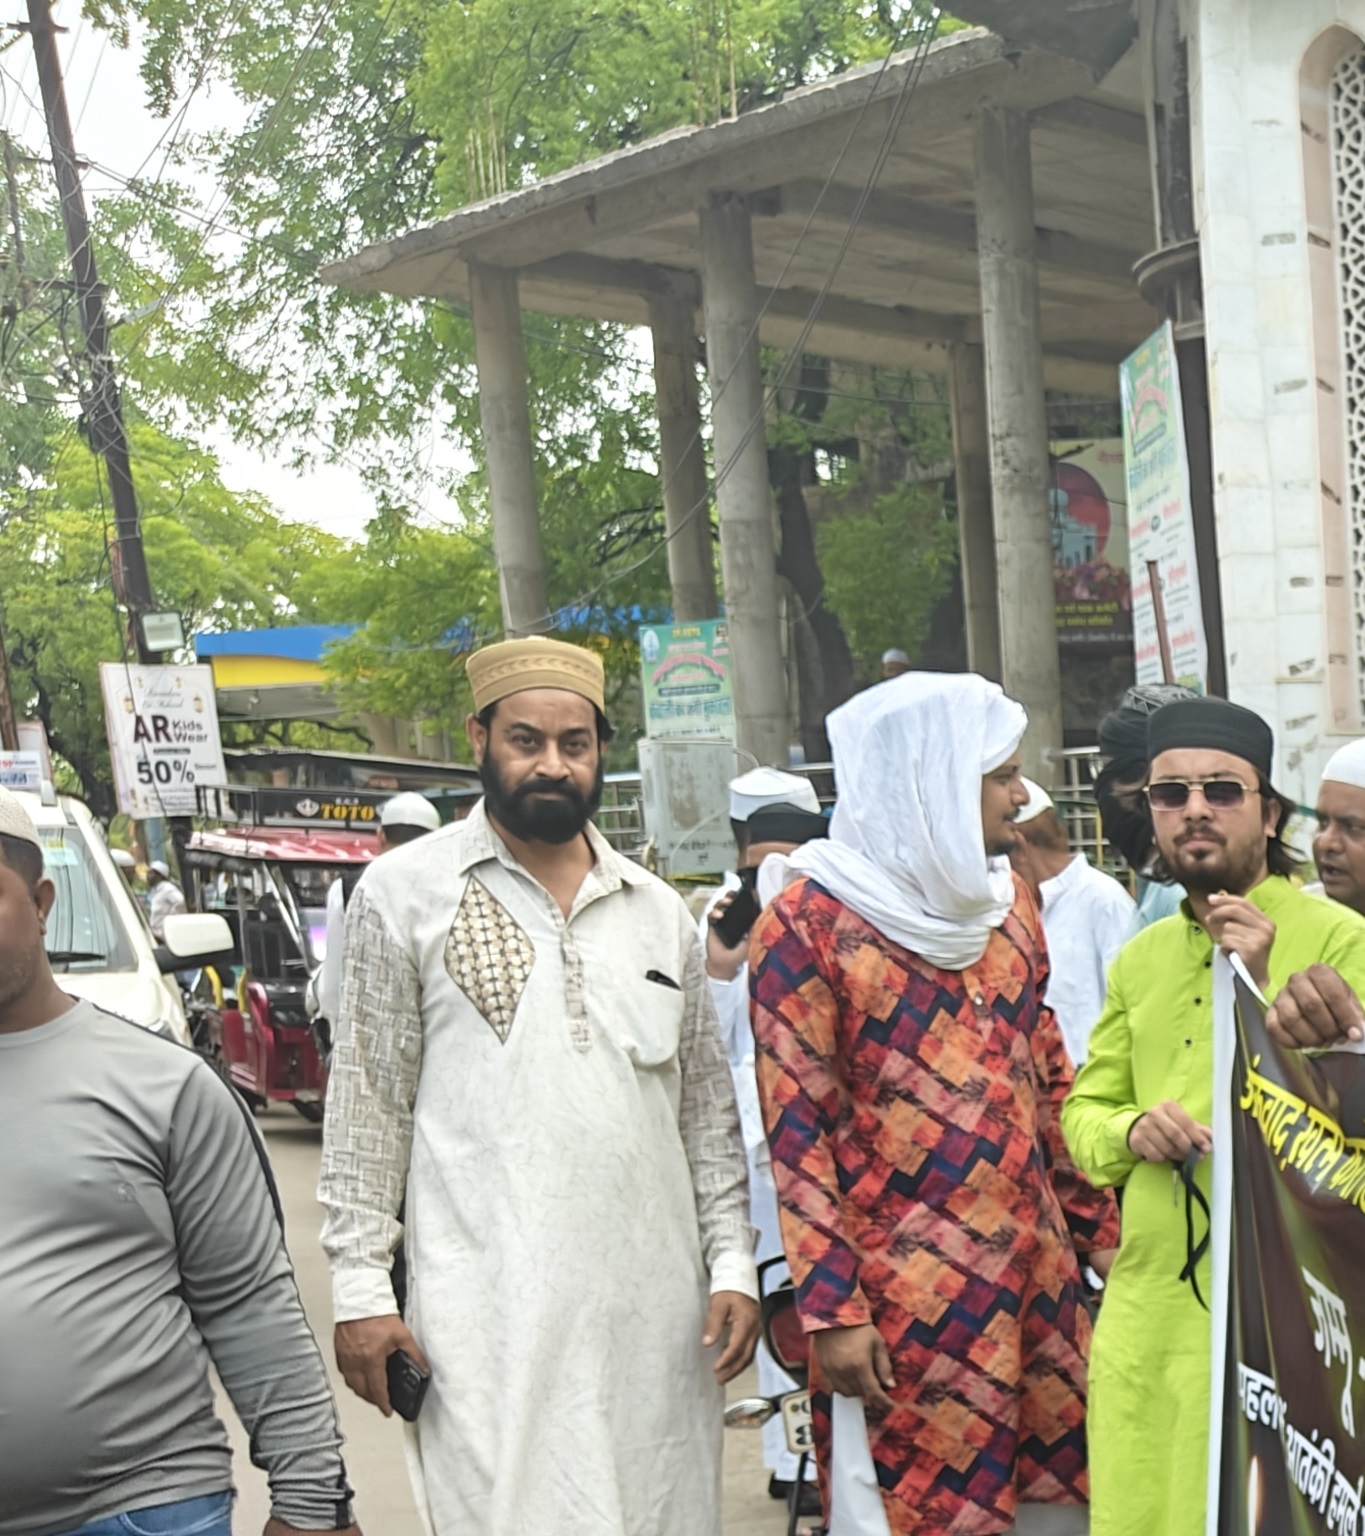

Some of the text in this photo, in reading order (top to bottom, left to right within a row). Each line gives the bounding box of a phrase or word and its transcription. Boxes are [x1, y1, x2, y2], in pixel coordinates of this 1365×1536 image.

[134, 715, 203, 743] AR Kids
[174, 732, 208, 743] Wear
[137, 760, 195, 784] 50%
[321, 803, 375, 821] TOTO
